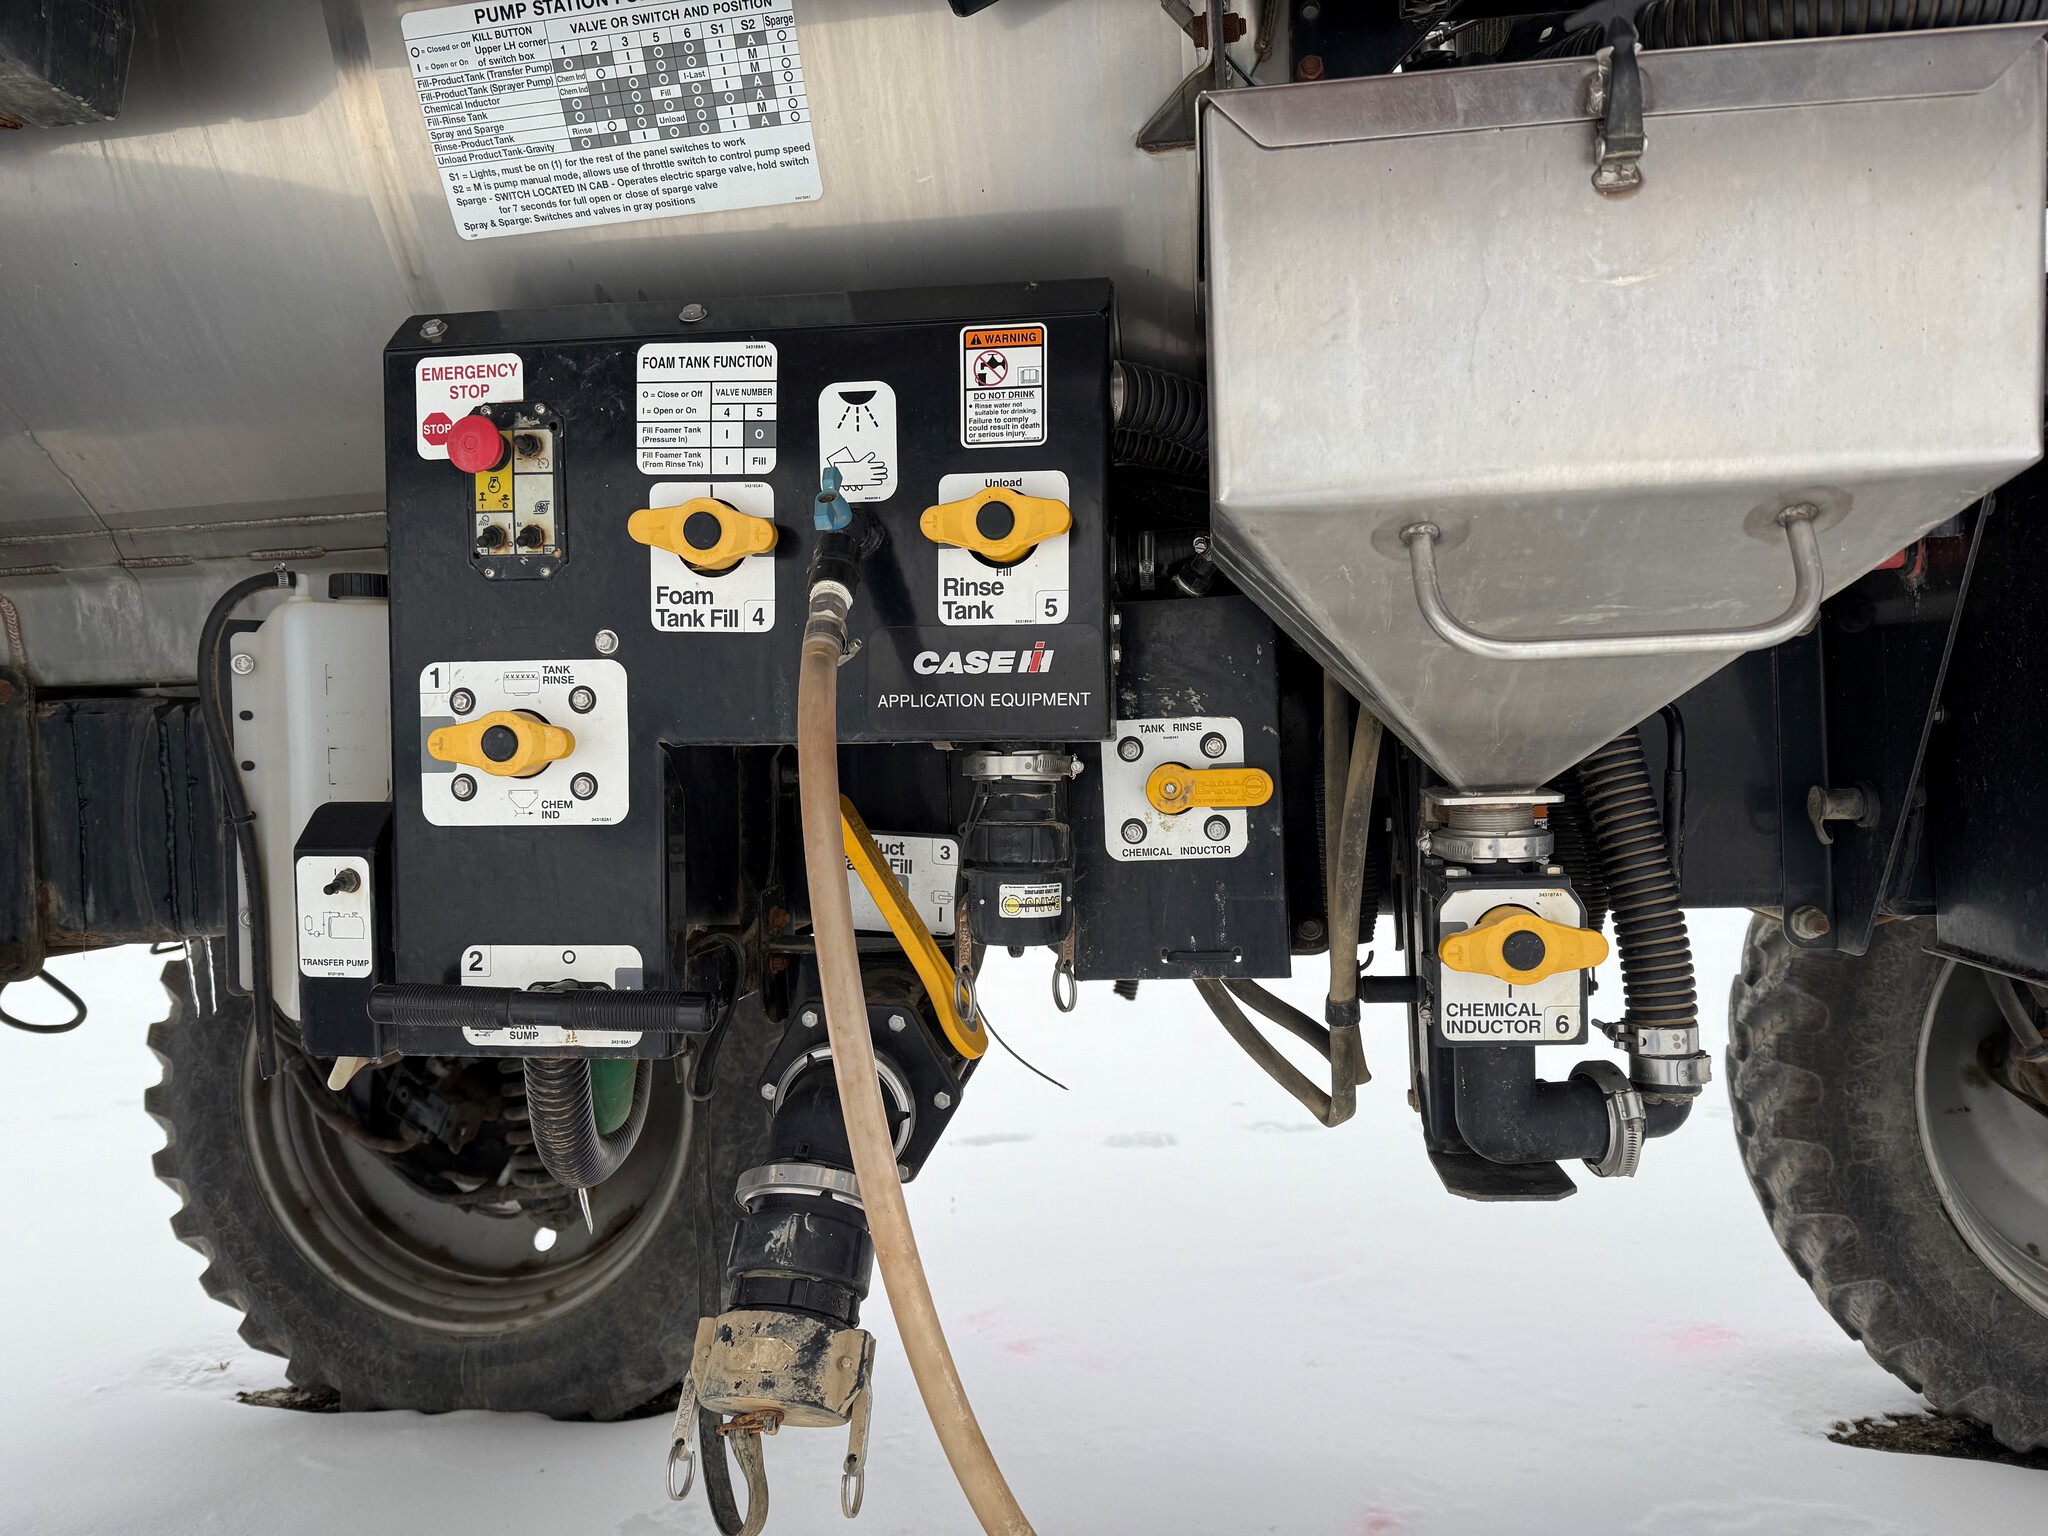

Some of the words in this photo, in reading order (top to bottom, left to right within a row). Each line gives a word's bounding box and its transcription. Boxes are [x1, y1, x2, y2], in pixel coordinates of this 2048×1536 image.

[474, 3, 527, 24] PUMP
[569, 18, 607, 33] VALVE
[610, 16, 628, 28] OR
[631, 8, 679, 25] SWITCH
[683, 4, 709, 18] AND
[712, 0, 772, 14] POSITION
[765, 14, 794, 26] Sparge
[710, 22, 724, 34] S1
[740, 18, 756, 30] S2
[471, 31, 493, 42] KILL
[494, 25, 532, 39] BUTTON
[652, 31, 660, 42] 5
[683, 27, 691, 38] 6
[474, 44, 501, 55] Upper
[503, 40, 516, 50] LH
[518, 38, 546, 48] corner
[590, 40, 598, 51] 2
[621, 35, 628, 47] 3
[560, 44, 566, 55] 1
[477, 57, 486, 67] of
[488, 53, 517, 65] switch
[517, 52, 535, 61] box
[417, 75, 464, 88] Fill-Product
[464, 72, 485, 81] Tank
[486, 67, 523, 80] (Transfer
[525, 62, 552, 73] Pump)
[423, 101, 463, 114] Chemical
[464, 97, 500, 109] Inductor
[426, 115, 466, 127] Fill-Rinse
[466, 111, 488, 121] Tank
[430, 130, 454, 141] Spray
[456, 126, 472, 138] and
[473, 124, 504, 136] Sparge
[433, 137, 494, 152] Rinse-Product
[493, 134, 515, 144] Tank
[437, 154, 467, 164] Unload
[468, 150, 502, 160] Product
[502, 144, 554, 156] Tank-Gravity
[448, 172, 460, 181] S1
[469, 168, 500, 179] Lights,
[500, 164, 523, 175] must
[523, 163, 536, 172] be
[537, 162, 549, 170] on
[550, 159, 562, 170] (1)
[564, 158, 577, 167] for
[578, 156, 593, 165] the
[595, 153, 613, 163] rest
[615, 151, 624, 160] of
[625, 150, 641, 159] the
[642, 146, 668, 159] panel
[669, 142, 709, 154] switches
[710, 140, 721, 149] to
[722, 136, 746, 147] work
[463, 222, 488, 231] Spray
[489, 219, 497, 227] &
[497, 217, 532, 227] Sparge:
[533, 211, 573, 222] Switches
[574, 207, 591, 217] and
[592, 206, 621, 215] valves
[622, 203, 631, 212] in
[632, 202, 652, 212] gray
[654, 197, 695, 210] positions
[984, 332, 1037, 344] WARNING
[643, 356, 675, 369] FOAM
[678, 356, 710, 368] TANK
[714, 355, 772, 368] FUNCTION
[421, 363, 518, 382] EMERGENCY
[449, 384, 490, 400] STOP
[657, 390, 679, 398] Close
[691, 390, 703, 398] Off
[715, 388, 740, 396] VALVE
[741, 388, 773, 396] NUMBER
[1008, 390, 1035, 398] DRINK
[653, 407, 673, 416] Open
[685, 406, 697, 414] On
[724, 407, 730, 417] 4
[756, 407, 763, 417] 5
[423, 424, 452, 435] STOP
[655, 426, 682, 434] Foamer
[642, 436, 677, 444] (Pressure
[678, 435, 688, 444] In)
[642, 451, 653, 459] Fill
[655, 451, 682, 459] Foamer
[752, 457, 766, 465] Fill
[642, 461, 663, 469] (From
[687, 460, 704, 469] Tnk)
[985, 477, 1022, 489] Unload
[944, 577, 1004, 597] Rinse
[656, 586, 714, 605] Foam
[942, 600, 994, 620] Tank
[1044, 598, 1058, 617] 5
[655, 608, 709, 628] Tank
[720, 609, 741, 628] Fill
[752, 607, 765, 626] 4
[542, 665, 571, 674] TANK
[913, 650, 1016, 675] CASE
[430, 667, 439, 688] 1
[542, 675, 575, 685] RINSE
[877, 693, 984, 708] APPLICATION
[991, 692, 1091, 707] EQUIPMENT
[1138, 724, 1165, 734] TANK
[1173, 722, 1202, 732] RINSE
[541, 800, 573, 809] CHEM
[541, 810, 560, 819] IND
[940, 845, 951, 860] 3
[1122, 846, 1173, 858] CHEMICAL
[1180, 845, 1231, 856] INDUCTOR
[890, 859, 912, 874] Fill
[302, 958, 344, 966] TRANSFER
[346, 959, 369, 967] PUMP
[469, 951, 483, 971] 2
[1446, 1002, 1542, 1017] CHEMICAL
[1446, 1019, 1541, 1034] INDUCTOR
[1555, 1015, 1569, 1034] 6
[509, 1031, 539, 1040] SUMP
